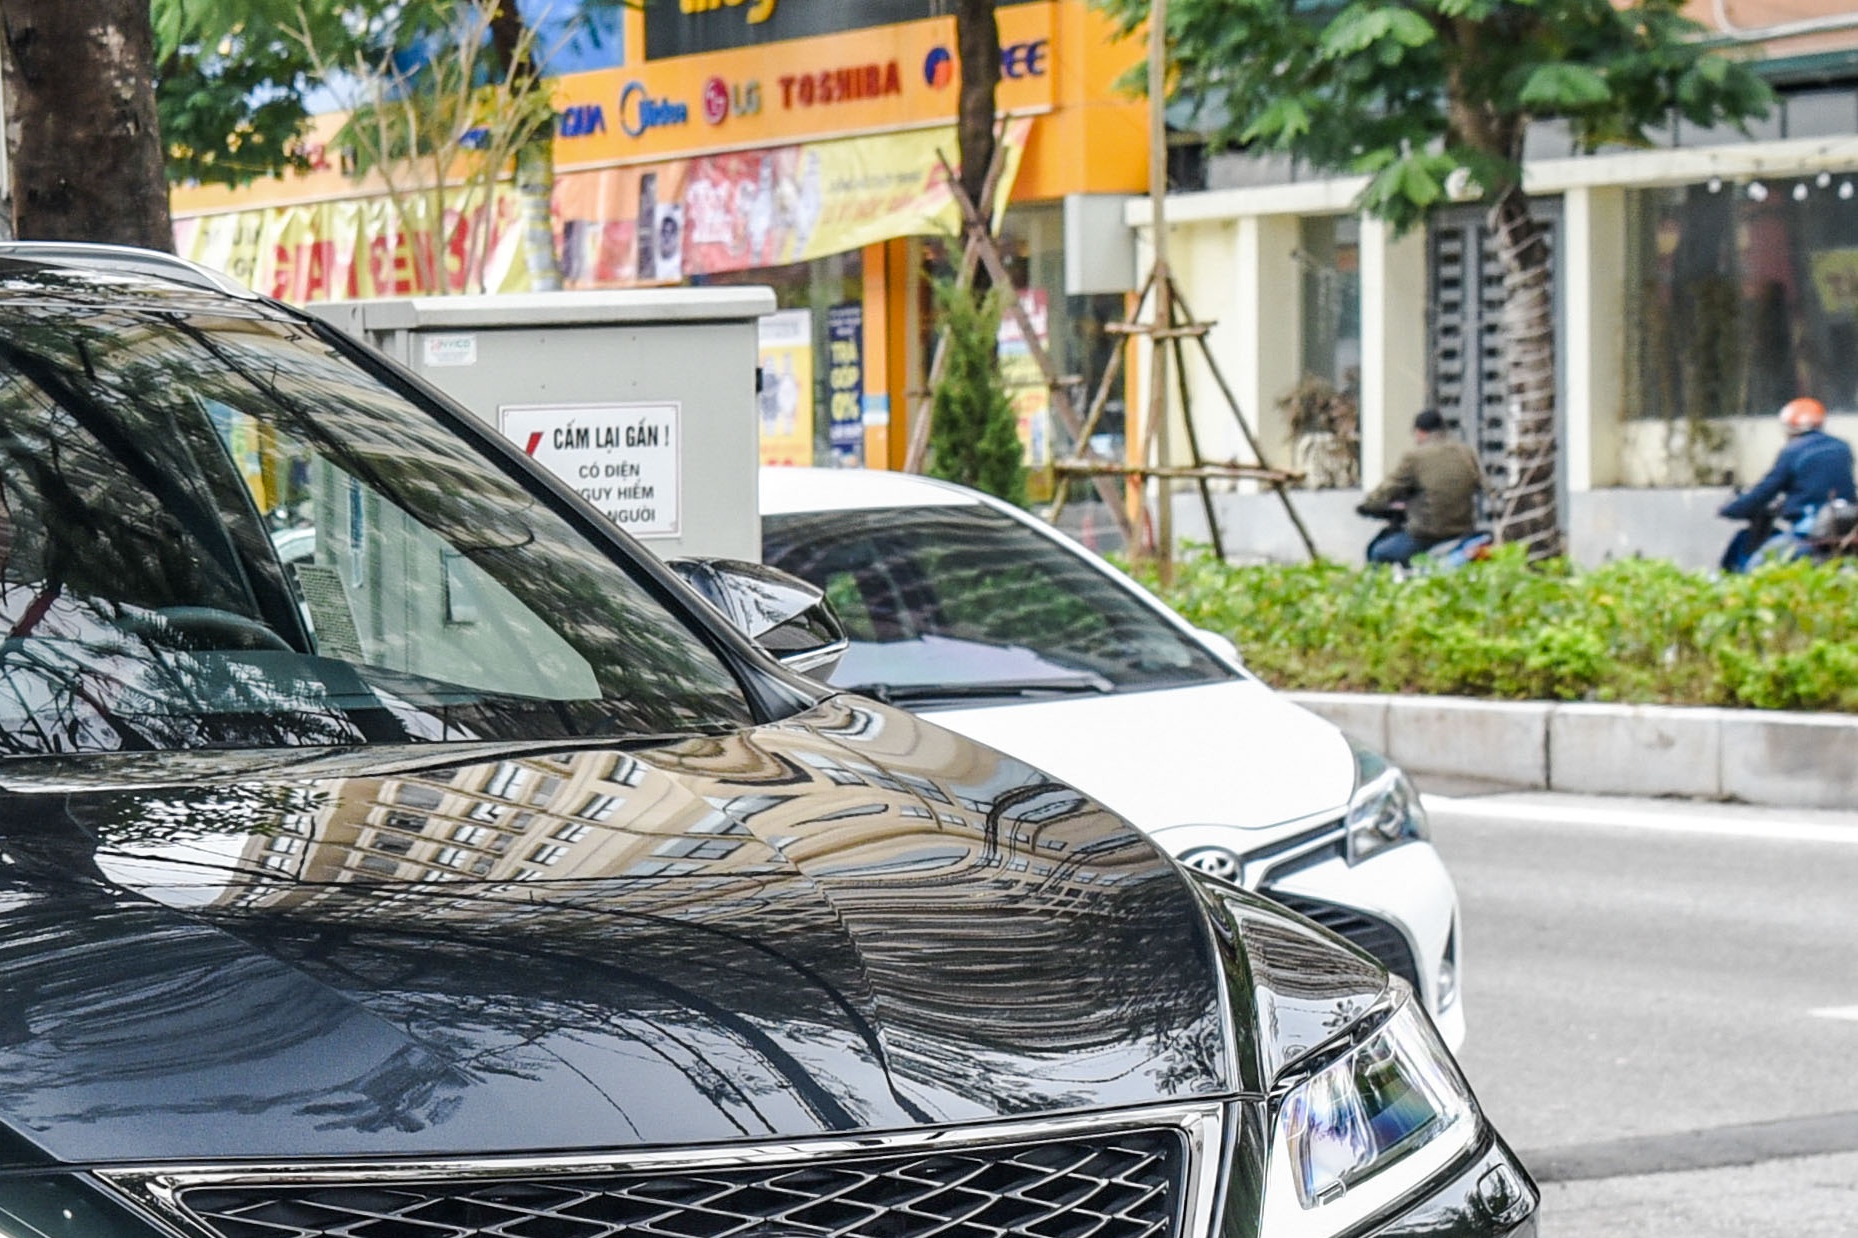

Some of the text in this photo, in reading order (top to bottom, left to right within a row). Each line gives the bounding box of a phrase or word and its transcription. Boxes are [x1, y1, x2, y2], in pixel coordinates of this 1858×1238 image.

[778, 60, 901, 110] TOSHIBA
[595, 427, 620, 454] LẠI
[579, 461, 600, 478] CÓ
[576, 487, 613, 501] GUY
